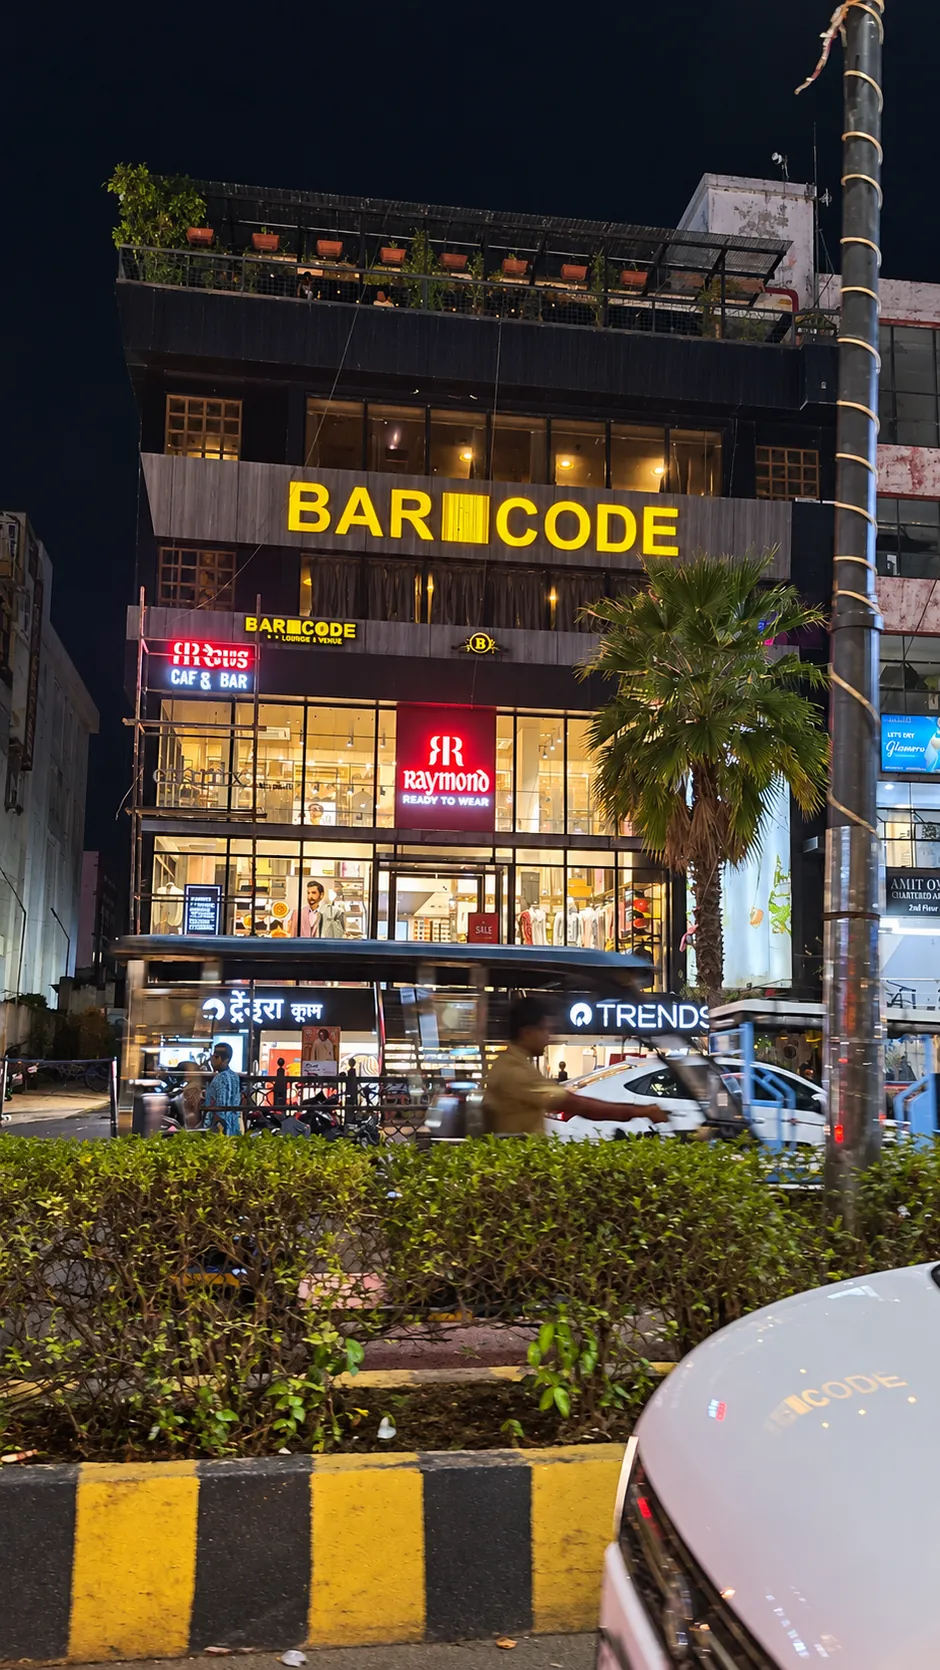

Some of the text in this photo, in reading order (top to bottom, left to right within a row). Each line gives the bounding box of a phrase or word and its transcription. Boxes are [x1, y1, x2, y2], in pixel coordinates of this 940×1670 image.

[287, 481, 680, 557] BAR CODE
[245, 616, 357, 639] BAR CODE
[219, 672, 248, 690] BAR
[402, 795, 490, 807] READY TO WEAR
[475, 925, 493, 935] SALE
[595, 1003, 710, 1029] TRENDS
